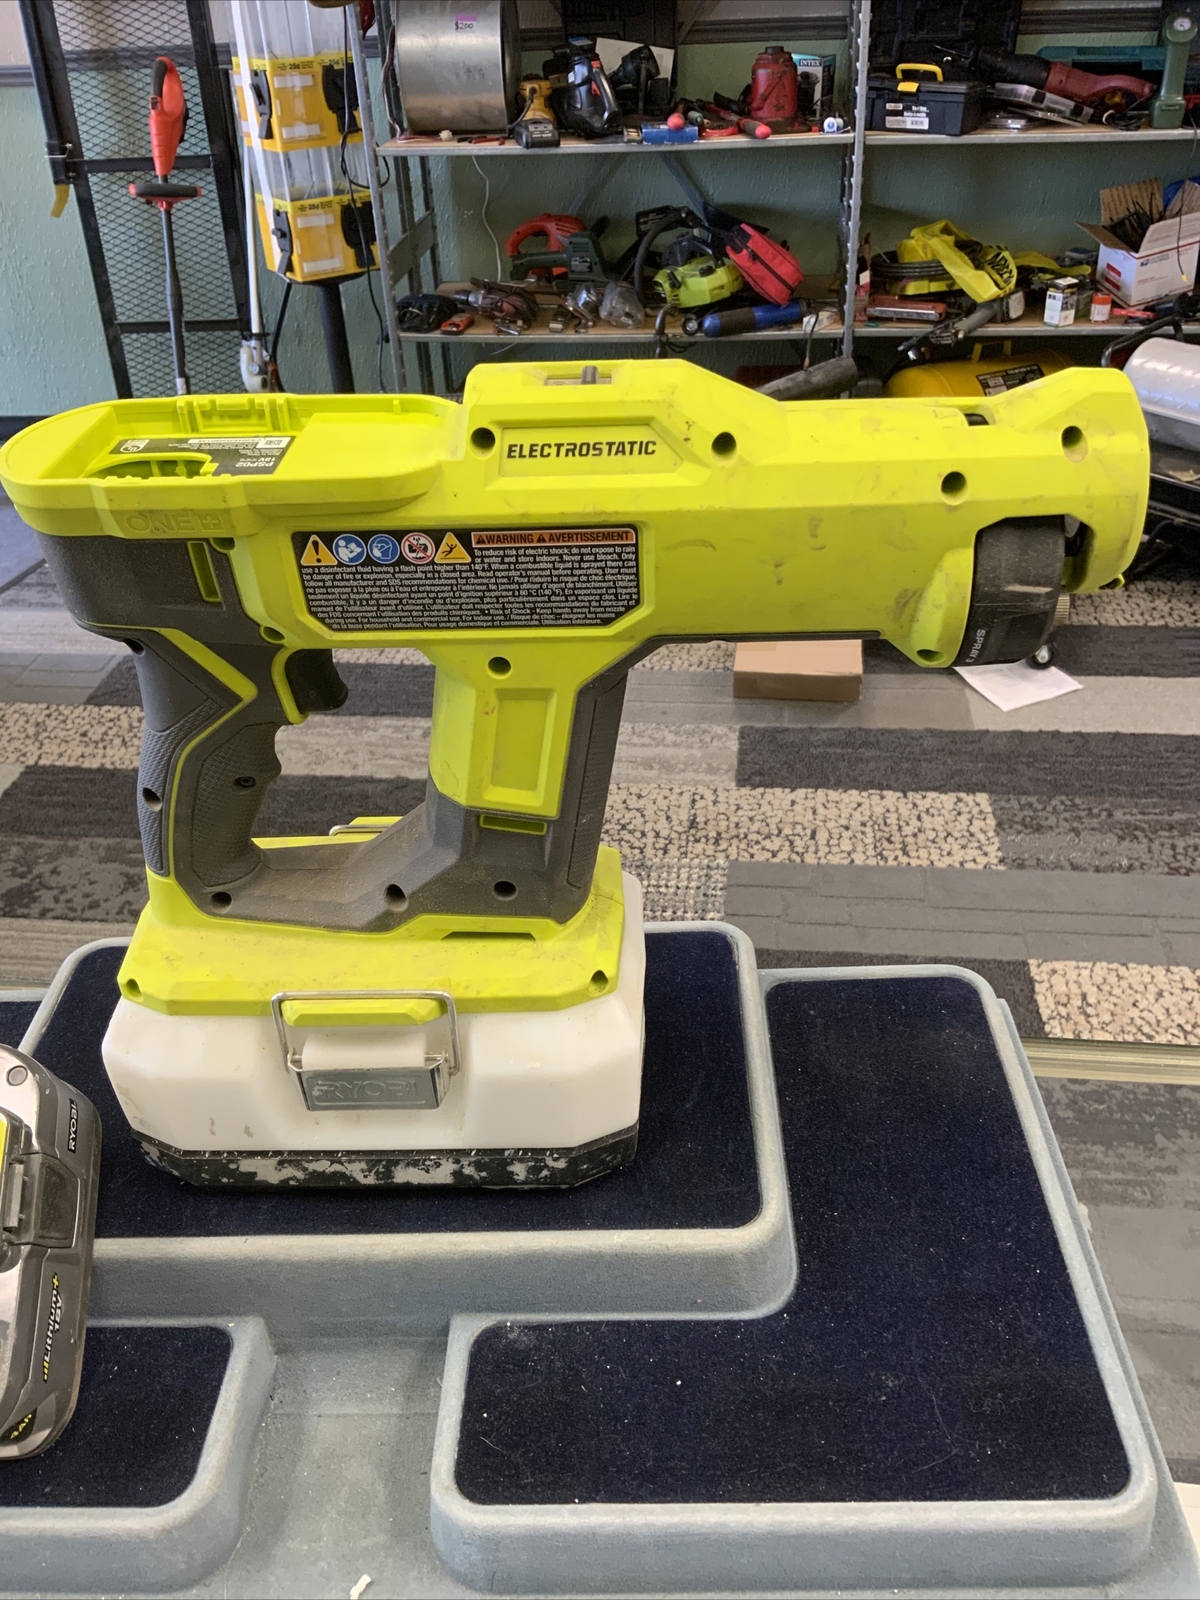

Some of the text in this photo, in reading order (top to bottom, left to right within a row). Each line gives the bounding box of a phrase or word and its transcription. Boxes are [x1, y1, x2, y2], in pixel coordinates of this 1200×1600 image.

[455, 21, 474, 31] $200
[506, 440, 657, 459] ELECTROSTATIC
[486, 531, 630, 544] WARNING AVERTISSEMENT
[969, 629, 986, 658] SPRAY
[314, 1080, 418, 1099] RYOBI
[68, 1104, 77, 1150] RYOBI
[54, 1294, 62, 1332] 18V
